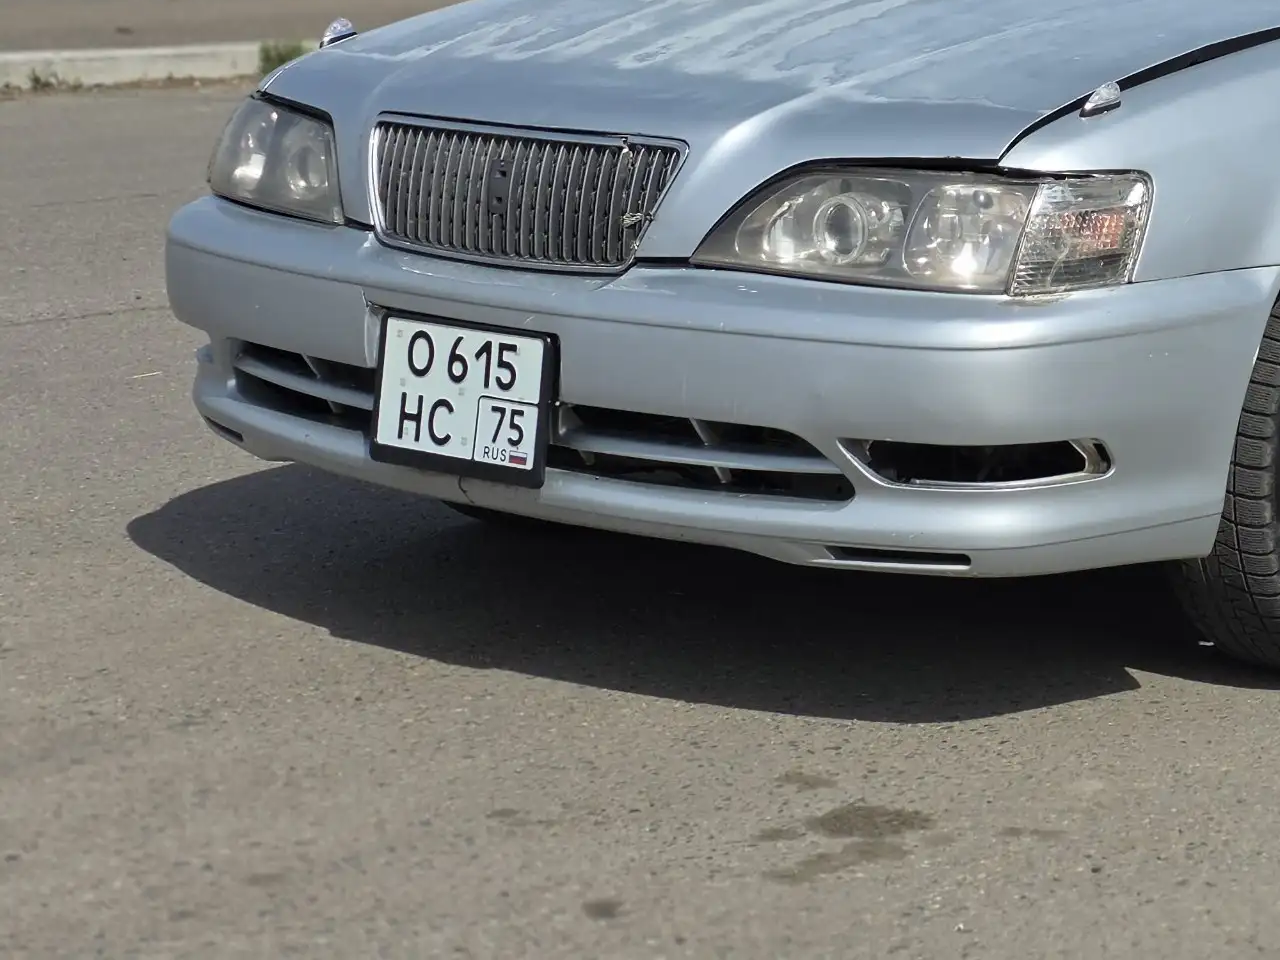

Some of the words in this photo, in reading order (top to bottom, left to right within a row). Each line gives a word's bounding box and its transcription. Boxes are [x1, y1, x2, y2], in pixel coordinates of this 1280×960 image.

[448, 336, 517, 391] 615
[491, 406, 524, 447] 75
[482, 446, 507, 461] RUS
